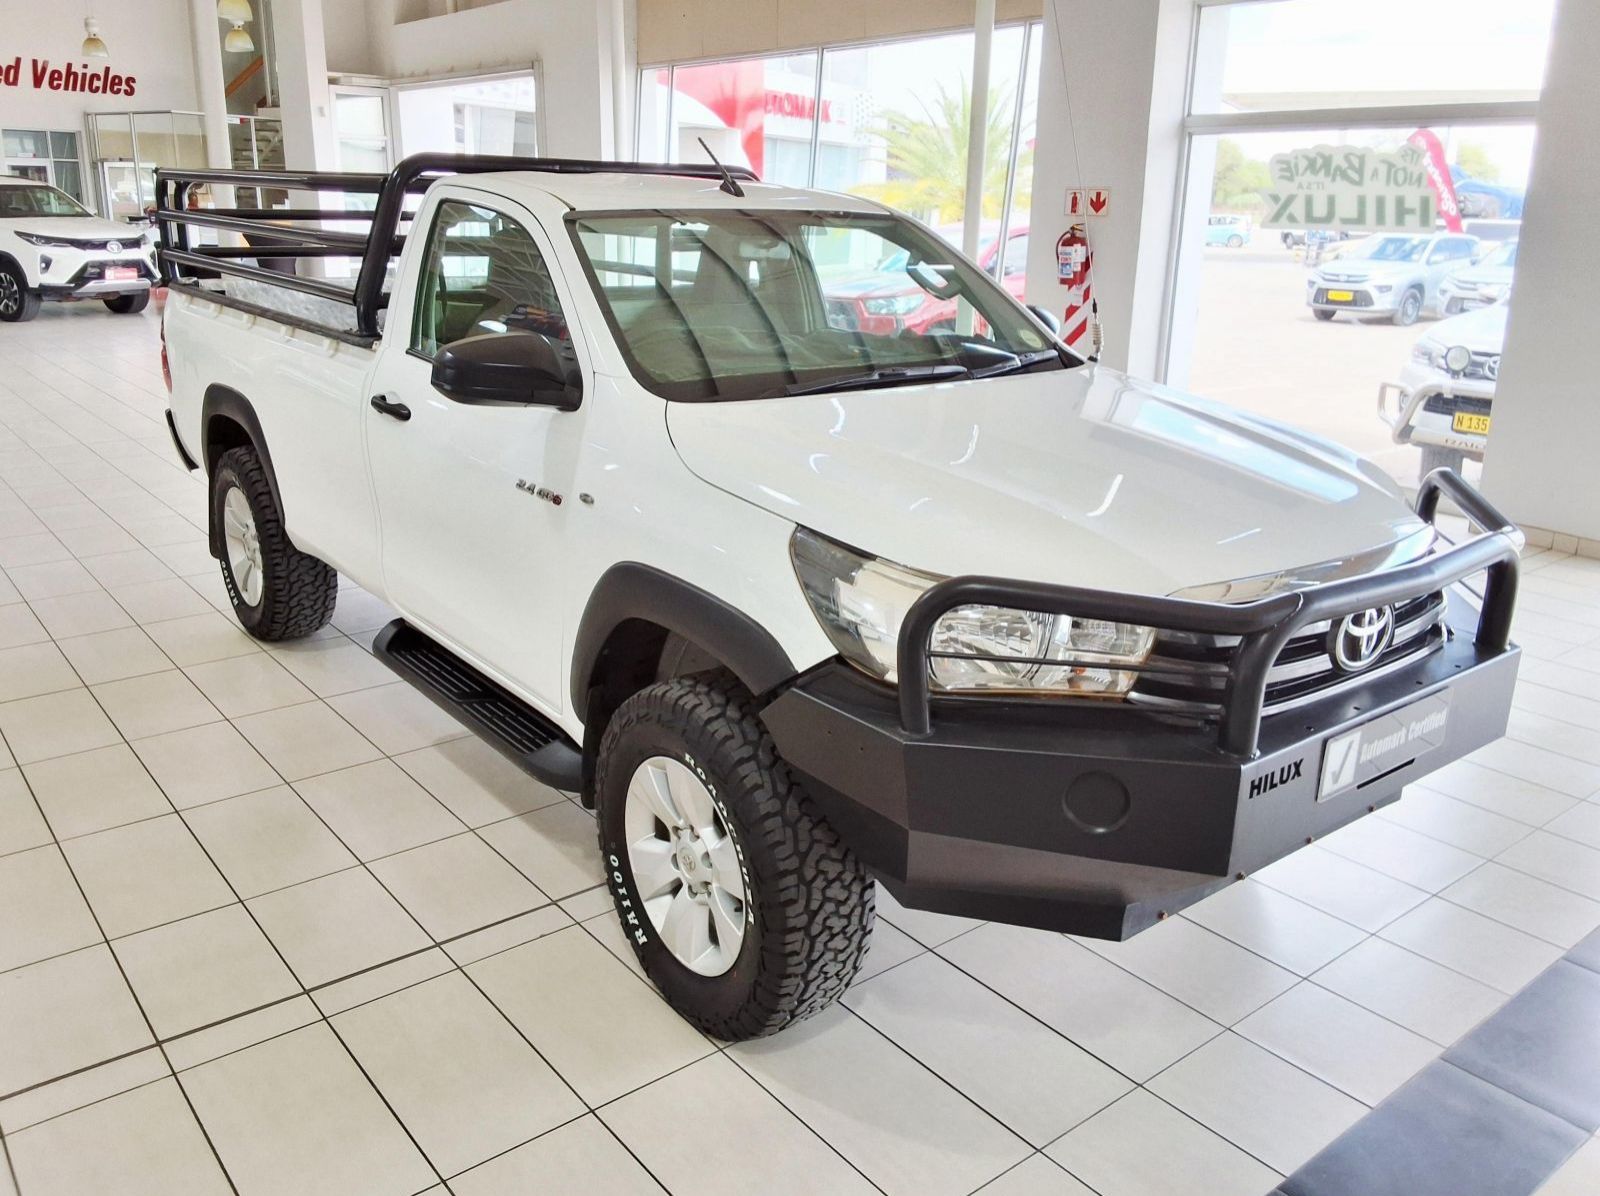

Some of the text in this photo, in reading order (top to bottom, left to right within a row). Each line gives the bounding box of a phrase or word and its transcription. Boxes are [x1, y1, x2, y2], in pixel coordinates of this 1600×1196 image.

[0, 57, 137, 96] d Vehicles
[1456, 415, 1464, 428] N
[1360, 727, 1406, 763] Automark
[1248, 757, 1305, 800] HILUX
